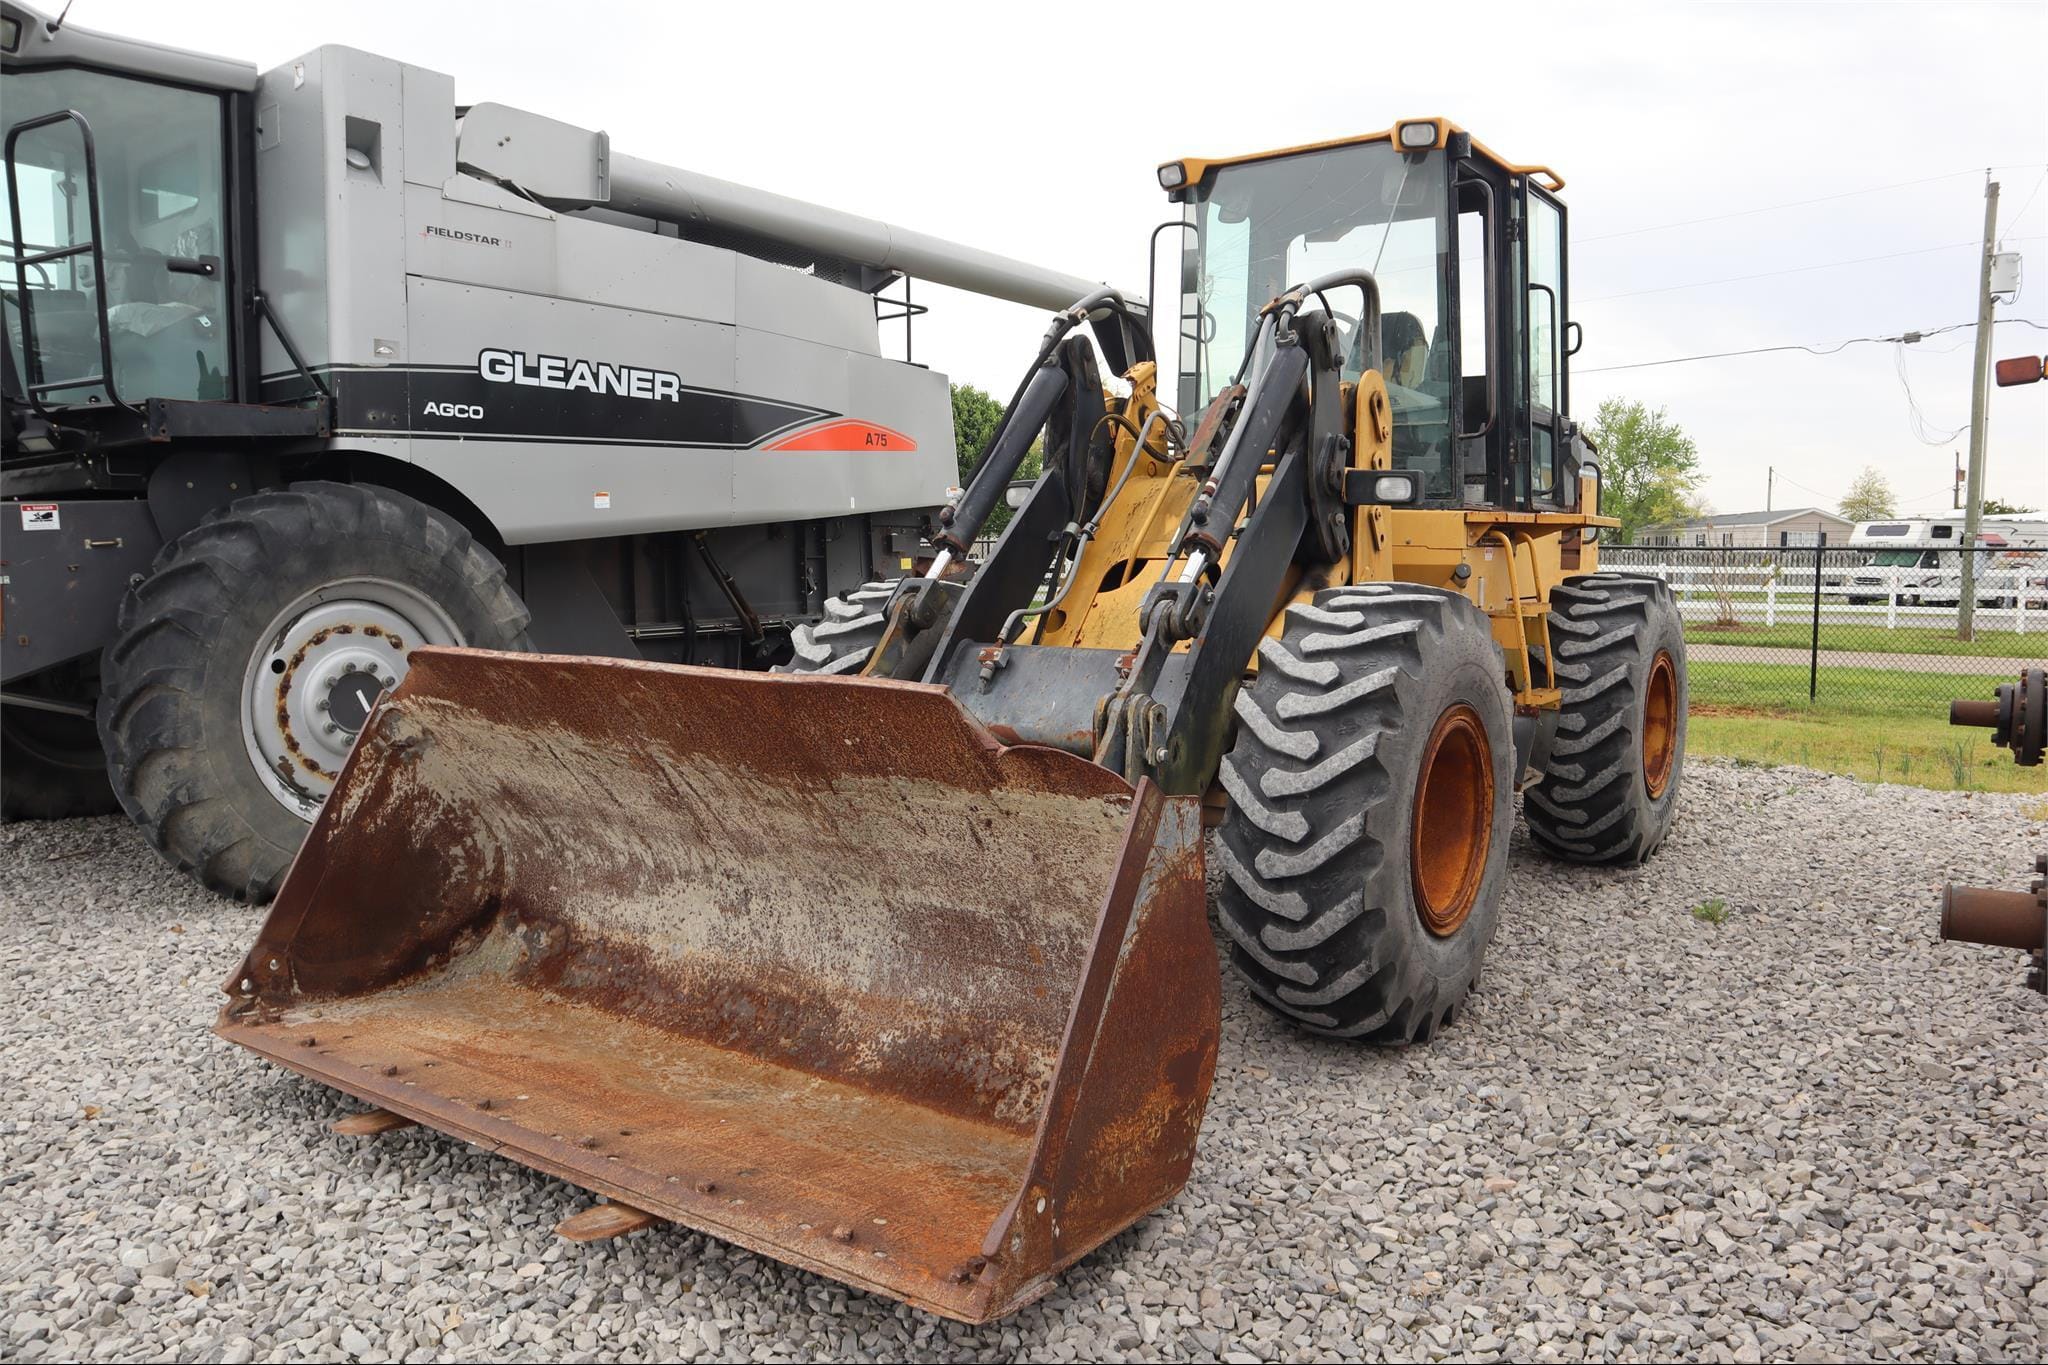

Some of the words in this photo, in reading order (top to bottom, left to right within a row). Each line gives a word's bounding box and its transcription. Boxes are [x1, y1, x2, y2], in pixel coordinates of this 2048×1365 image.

[426, 225, 500, 246] FIELDSTAR
[479, 349, 681, 403] GLEANER
[423, 401, 484, 420] AGCO
[865, 432, 888, 447] A75
